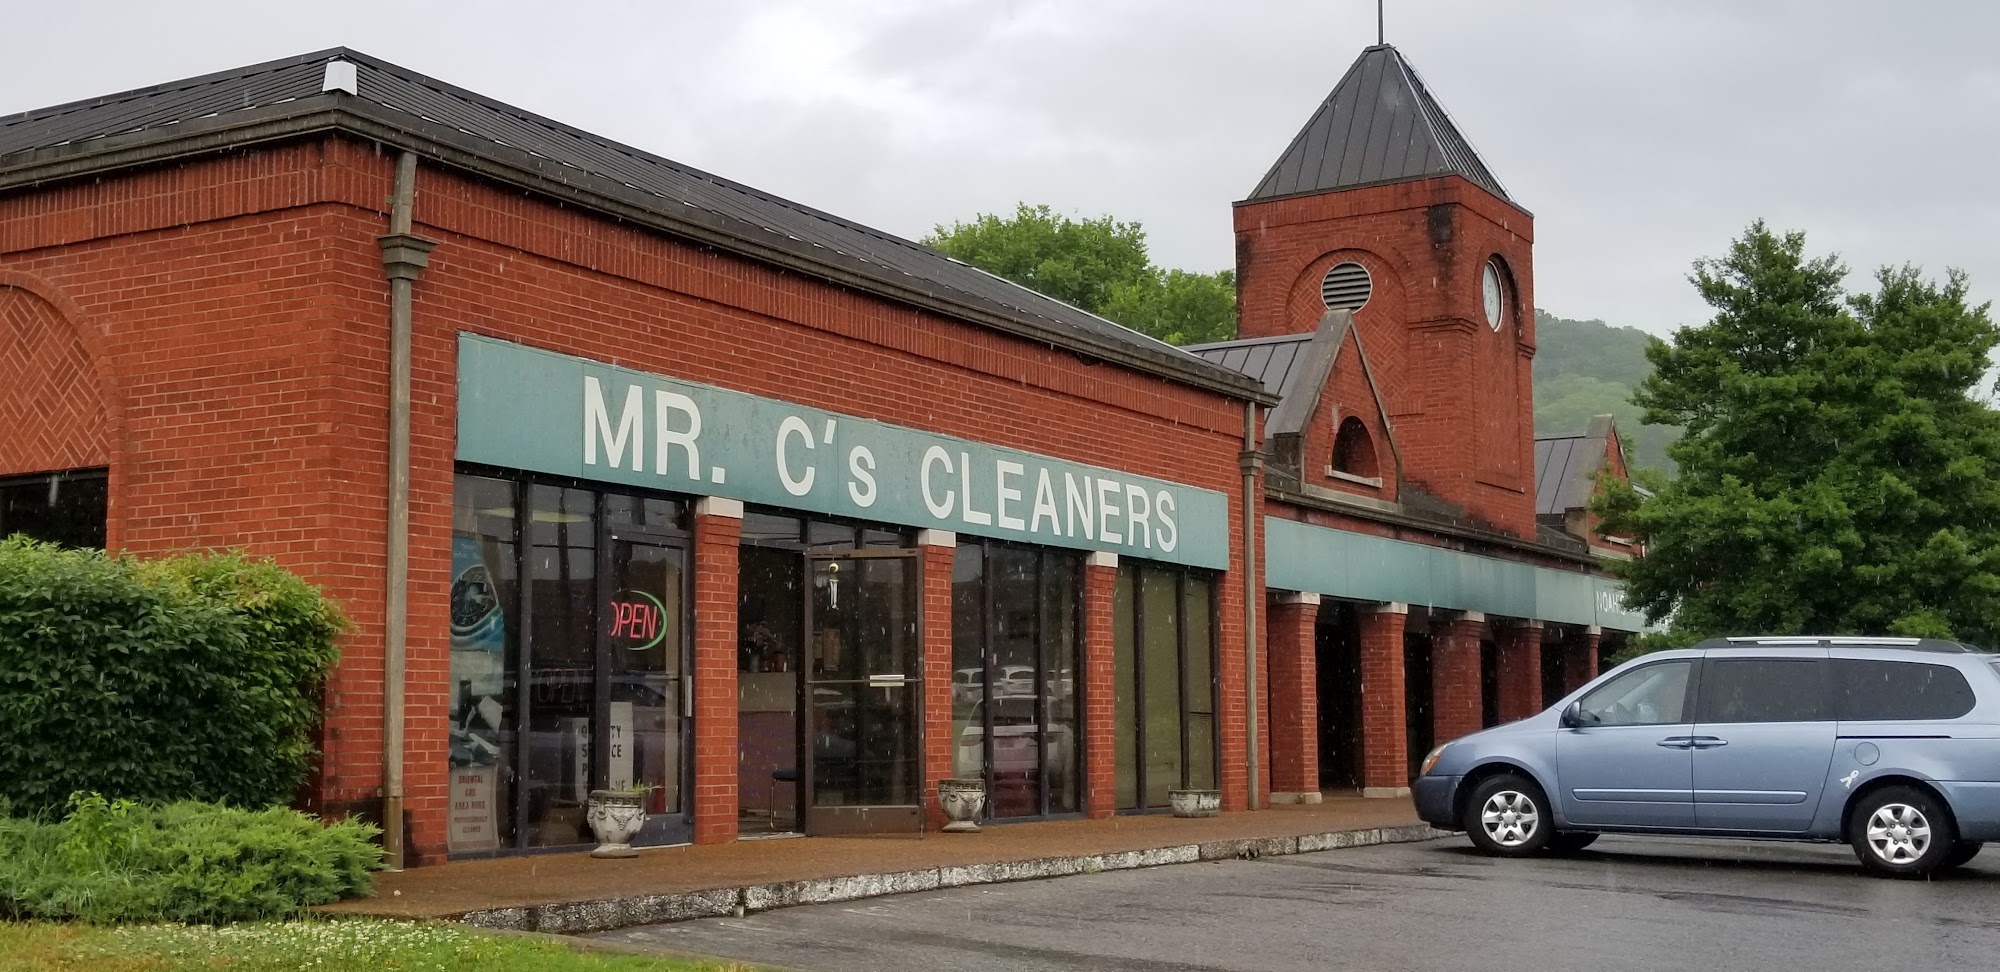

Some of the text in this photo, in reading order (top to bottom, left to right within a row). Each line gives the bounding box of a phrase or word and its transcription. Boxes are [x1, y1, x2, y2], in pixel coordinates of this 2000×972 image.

[584, 376, 1179, 553] MR. C's CLEANERS
[458, 775, 483, 784] ORIENTAL
[465, 788, 476, 797] AND
[455, 801, 485, 810] AREA RUGS
